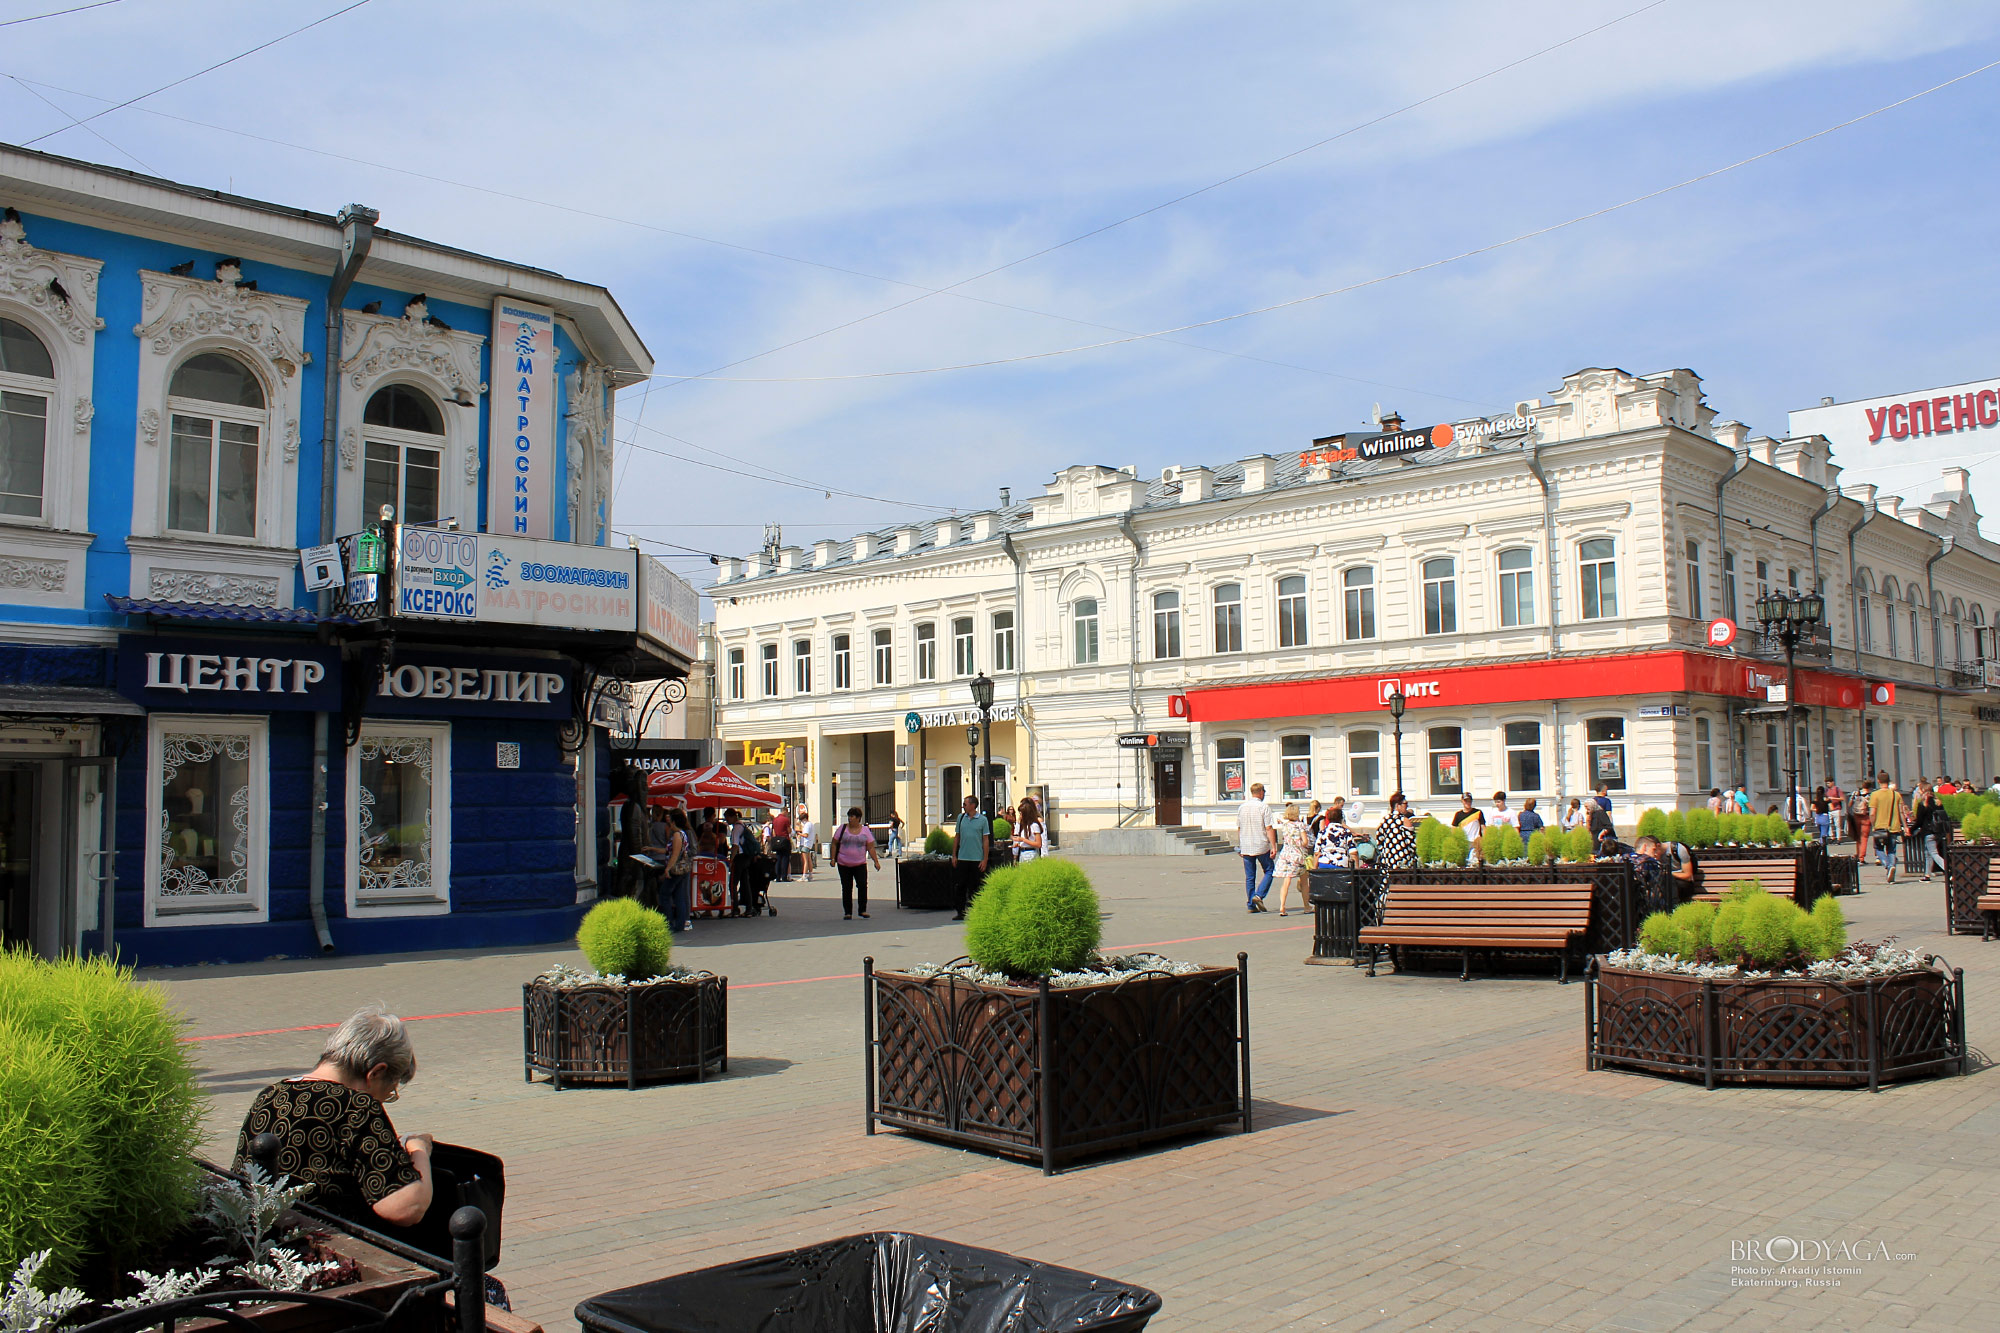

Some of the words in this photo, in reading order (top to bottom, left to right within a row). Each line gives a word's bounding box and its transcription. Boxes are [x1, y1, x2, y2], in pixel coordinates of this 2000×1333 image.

[502, 306, 550, 325] ЗООМАГАЗИН
[1865, 388, 2000, 443] УСПЕНС
[514, 356, 533, 533] МАТРОСКИН
[1299, 452, 1318, 468] 24
[1320, 447, 1357, 464] часа
[1362, 433, 1426, 458] Winline
[1454, 414, 1537, 443] Букмекер
[404, 531, 475, 567] ФОТО
[435, 571, 465, 585] ВХОД
[520, 562, 629, 590] ЗООМАГАЗИН
[403, 587, 475, 616] КСЕРОКС
[484, 588, 630, 618] МАТРОСКИН
[648, 598, 698, 657] МАТРОСКИН
[144, 652, 325, 694] ЦЕНТР
[376, 664, 565, 703] ЮВЕЛИР
[1404, 681, 1440, 698] МТС
[1120, 737, 1145, 745] Winline
